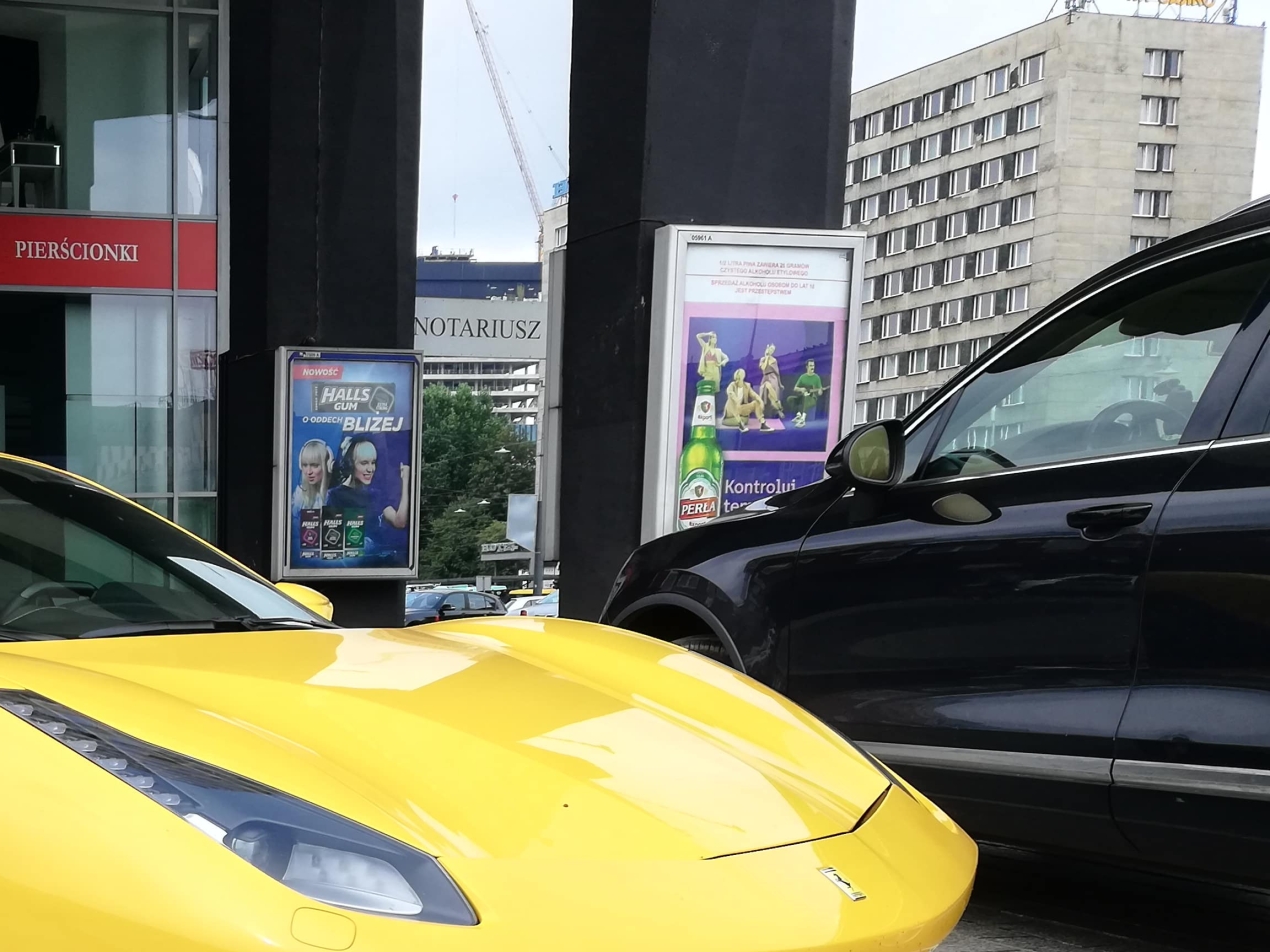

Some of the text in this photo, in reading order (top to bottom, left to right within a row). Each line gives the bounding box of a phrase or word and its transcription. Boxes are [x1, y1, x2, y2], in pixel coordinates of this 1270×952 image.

[14, 236, 139, 262] PIERŚCIONKI
[414, 316, 541, 339] NOTARIUSZ
[302, 367, 338, 376] NOWOŚĆ
[321, 386, 371, 403] HALLS
[334, 402, 358, 411] GUM
[310, 416, 343, 424] ODDECH
[342, 411, 403, 432] BLIŻEJ
[681, 499, 716, 516] PERŁA
